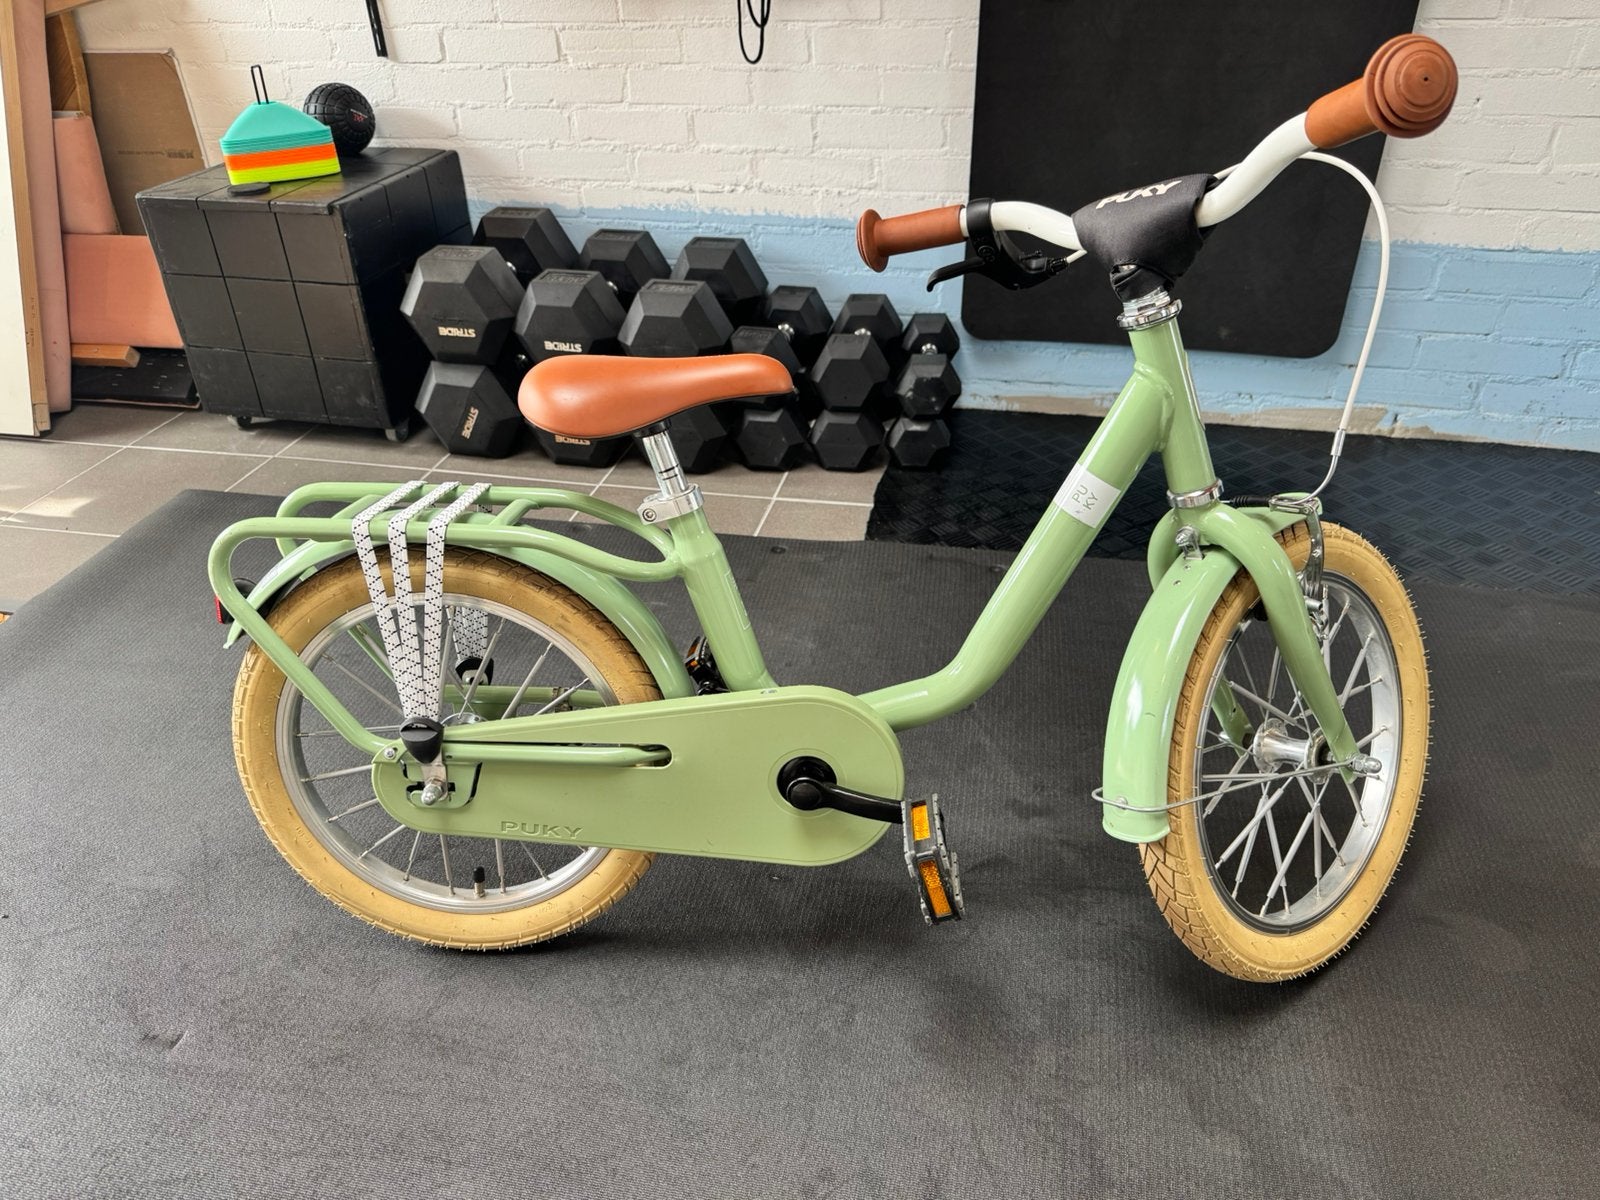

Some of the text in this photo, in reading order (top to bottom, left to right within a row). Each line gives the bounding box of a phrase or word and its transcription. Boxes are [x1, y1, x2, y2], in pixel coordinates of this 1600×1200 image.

[1095, 180, 1183, 210] PUKY
[437, 326, 477, 338] STRIDE
[543, 340, 583, 353] STRIDE
[461, 406, 479, 439] STRIDE
[1071, 484, 1089, 504] PU
[1082, 491, 1099, 511] KY
[500, 820, 584, 840] PUKY
